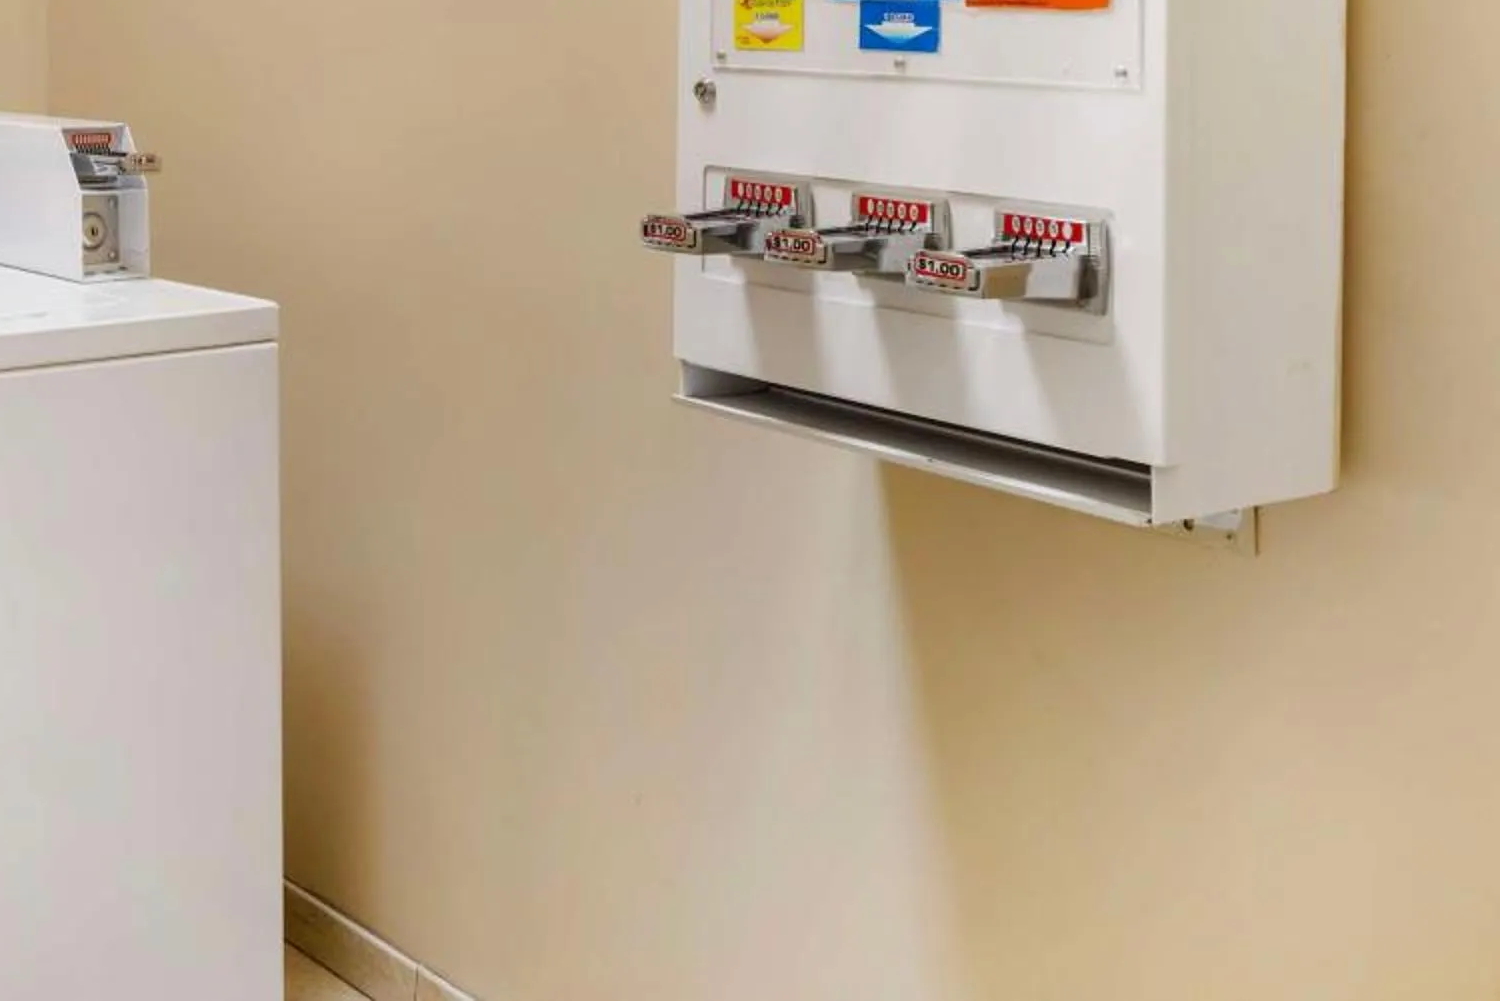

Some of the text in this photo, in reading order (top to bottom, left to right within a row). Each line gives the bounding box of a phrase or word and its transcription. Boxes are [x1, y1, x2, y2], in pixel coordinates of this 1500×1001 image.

[650, 222, 681, 238] $1.00
[773, 236, 811, 252] $1.00
[917, 258, 960, 276] $1.00
